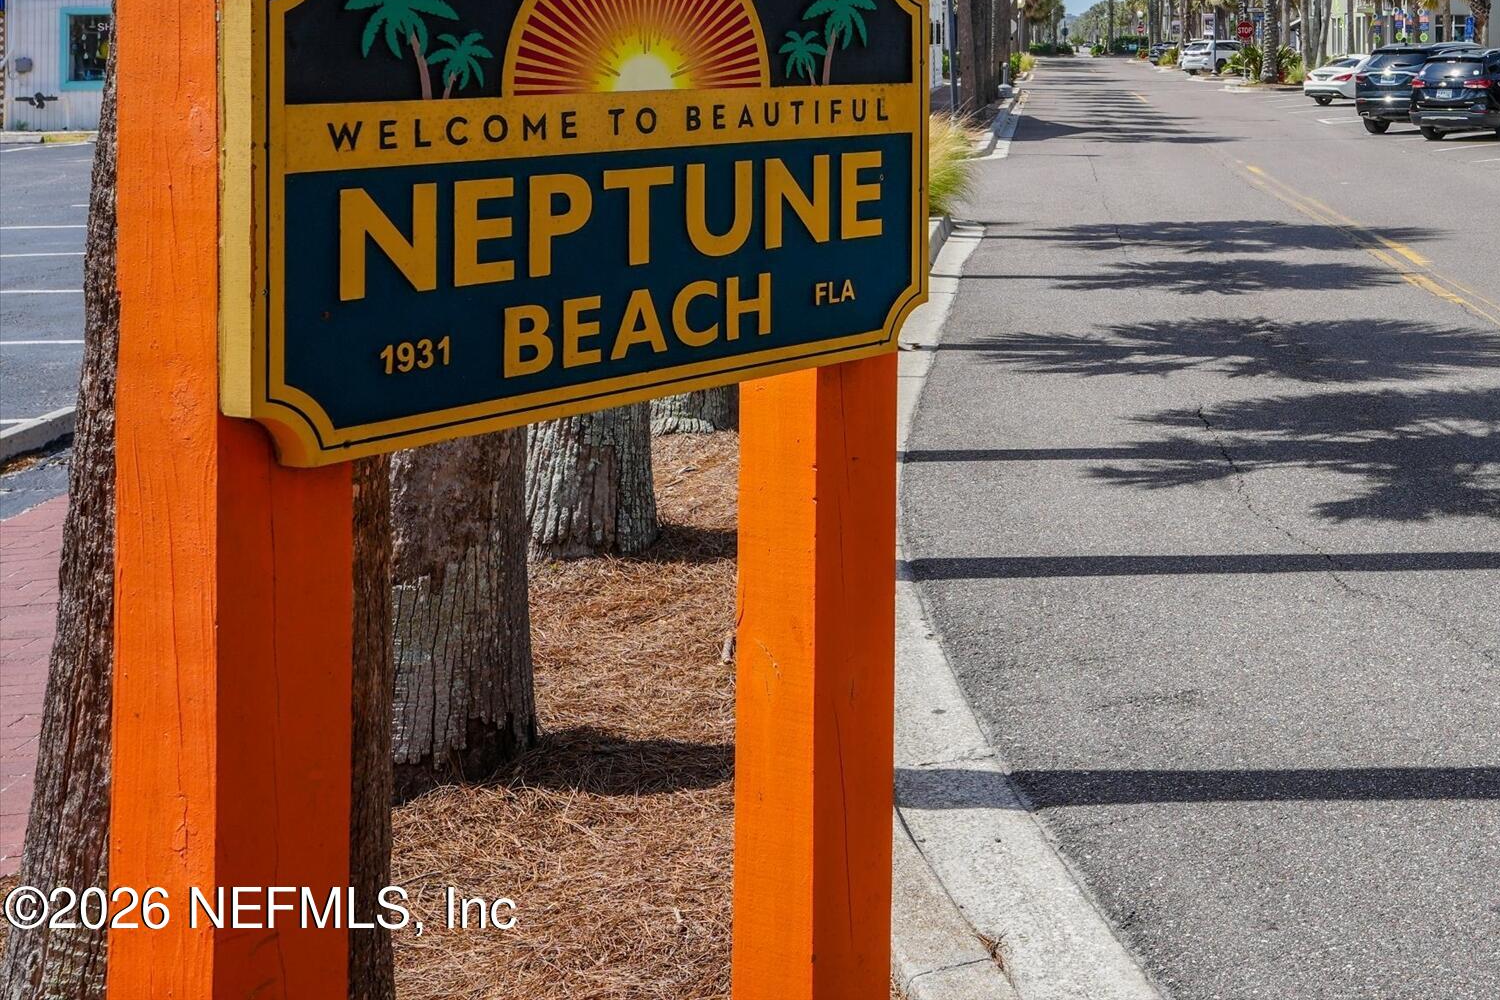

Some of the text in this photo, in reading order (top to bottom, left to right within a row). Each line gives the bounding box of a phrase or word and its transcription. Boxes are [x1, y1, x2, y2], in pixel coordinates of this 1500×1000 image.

[97, 22, 111, 32] SH
[1237, 26, 1253, 35] STOP
[326, 96, 890, 153] WELCOME TO BEAUTIFUL
[338, 150, 884, 302] NEPTUNE
[815, 279, 856, 306] FLA
[502, 272, 771, 379] BEACH
[379, 336, 451, 374] 1931
